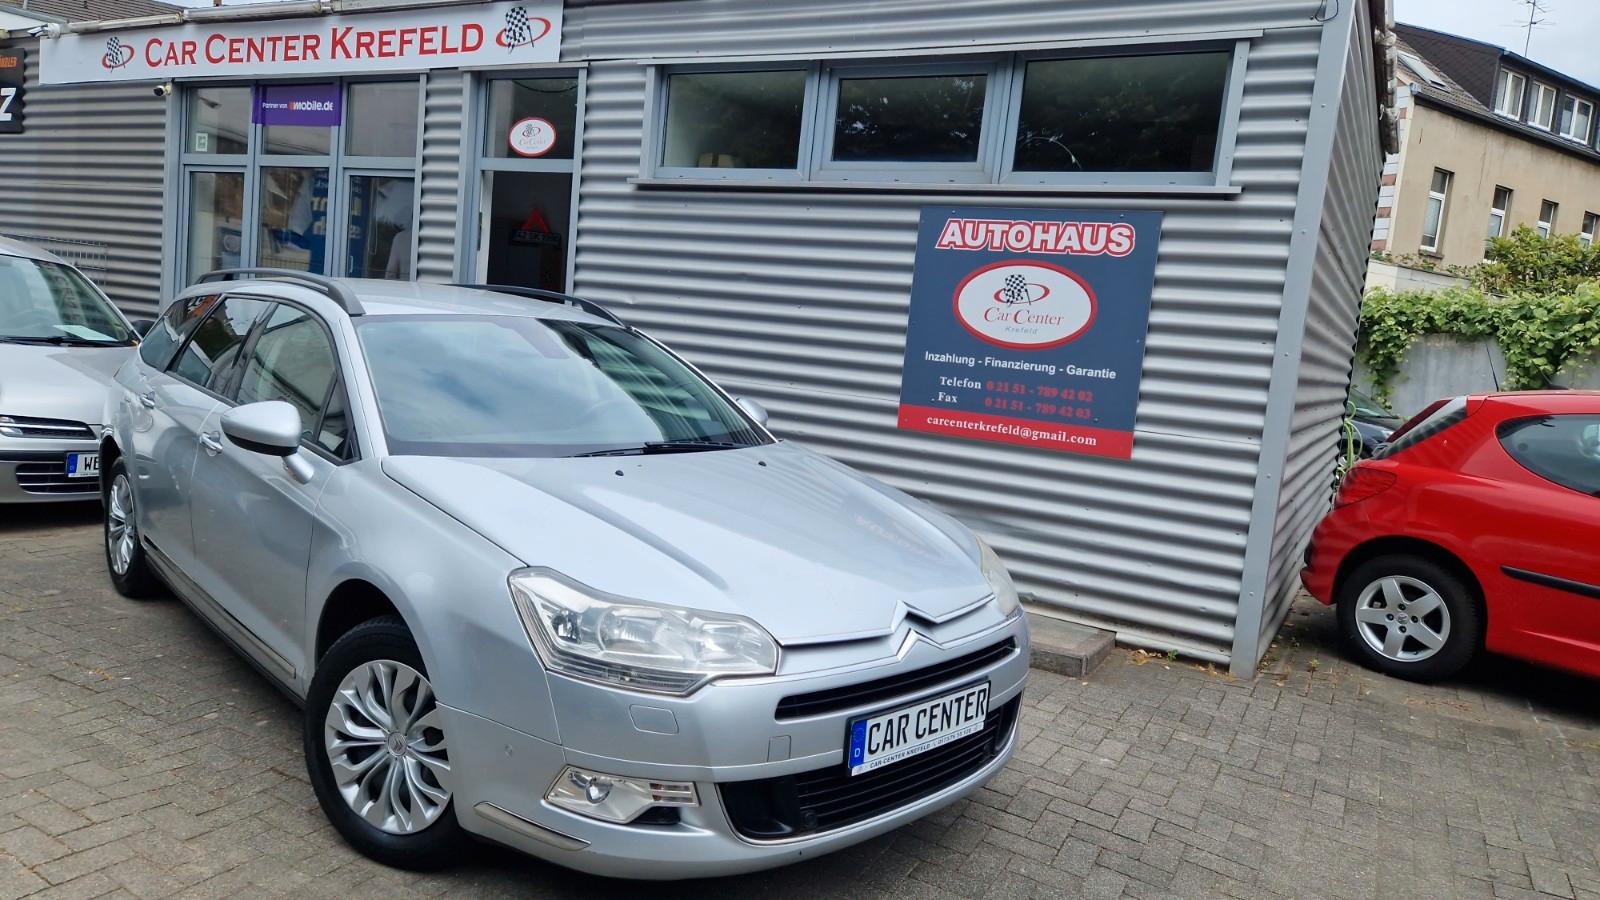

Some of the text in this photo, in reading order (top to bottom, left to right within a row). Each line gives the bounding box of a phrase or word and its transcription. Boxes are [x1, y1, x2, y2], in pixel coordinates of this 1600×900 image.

[145, 24, 484, 67] CAR CENTER KREFELD
[935, 218, 1135, 257] AUTOHAUS
[983, 306, 1064, 327] Car Center
[1005, 326, 1039, 335] Krefeld
[925, 351, 975, 368] Inzahlung
[985, 357, 1056, 375] Finanzierung
[1066, 364, 1117, 380] Garantie
[937, 391, 958, 404] Fax
[940, 376, 982, 390] Telefon
[927, 415, 1097, 446] carcenterkrefeld@gmail.com
[867, 688, 987, 755] CAR CENTER
